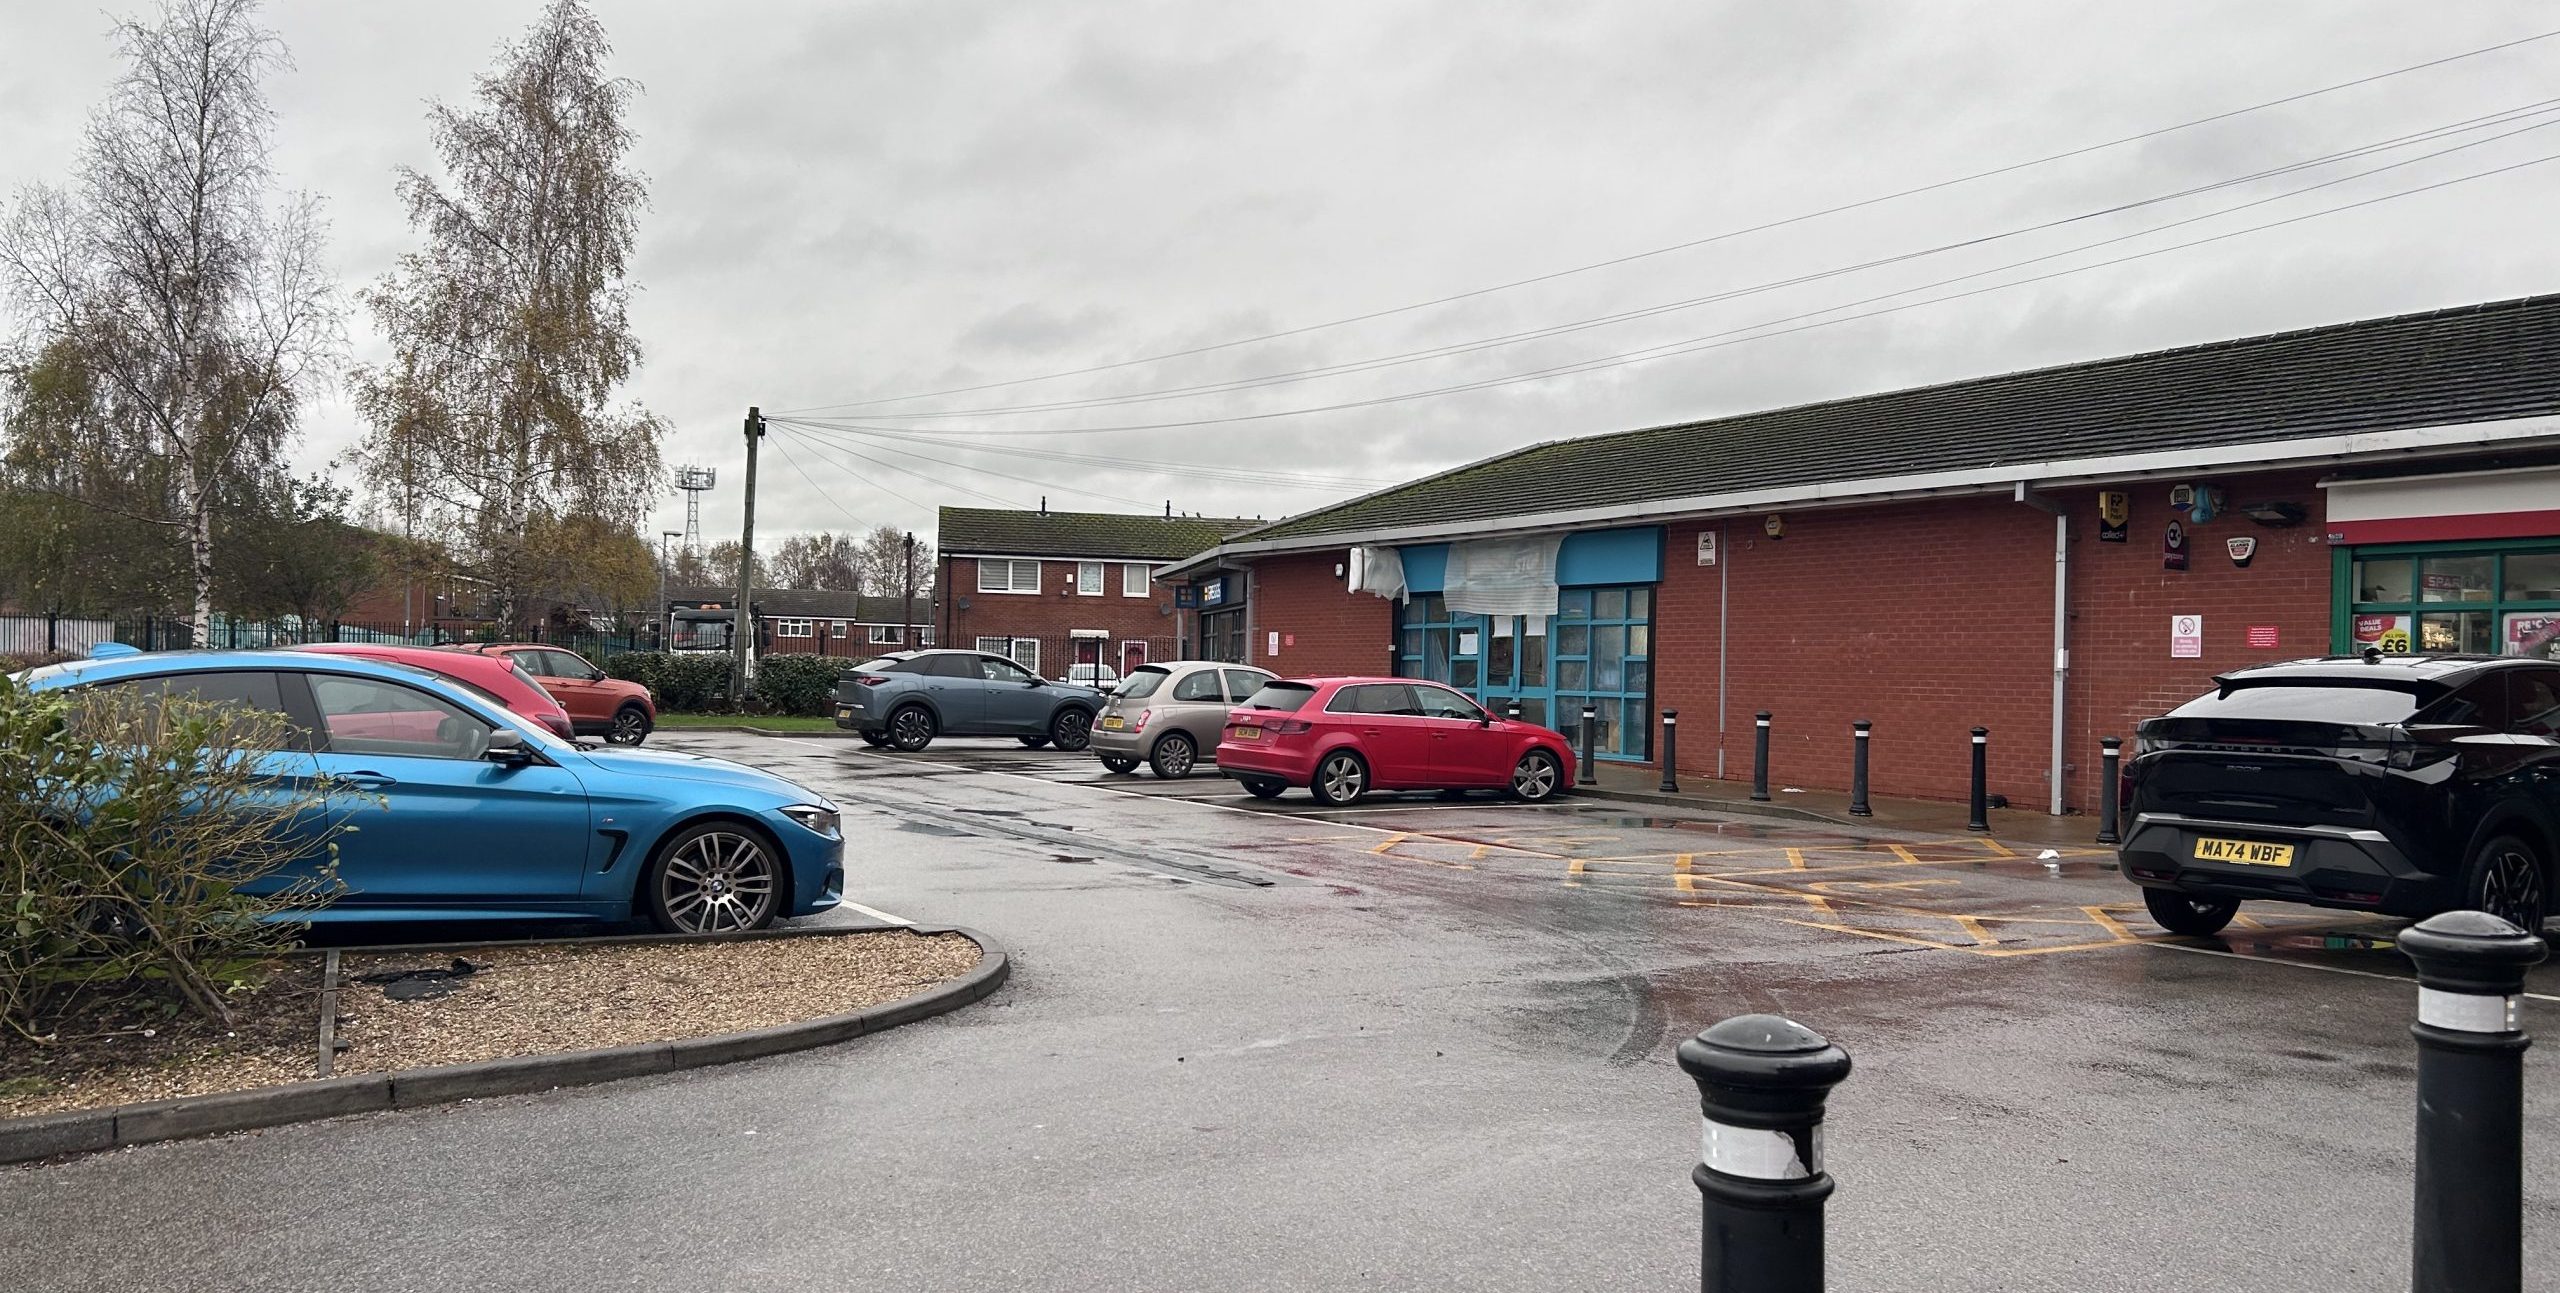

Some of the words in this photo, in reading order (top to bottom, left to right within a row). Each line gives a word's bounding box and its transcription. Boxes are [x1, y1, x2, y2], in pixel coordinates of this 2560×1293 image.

[2427, 576, 2461, 588] SPAR
[2358, 619, 2382, 627] VALUE
[2382, 639, 2408, 653] £6
[2202, 841, 2245, 859] MA74
[2250, 844, 2285, 862] WBF
